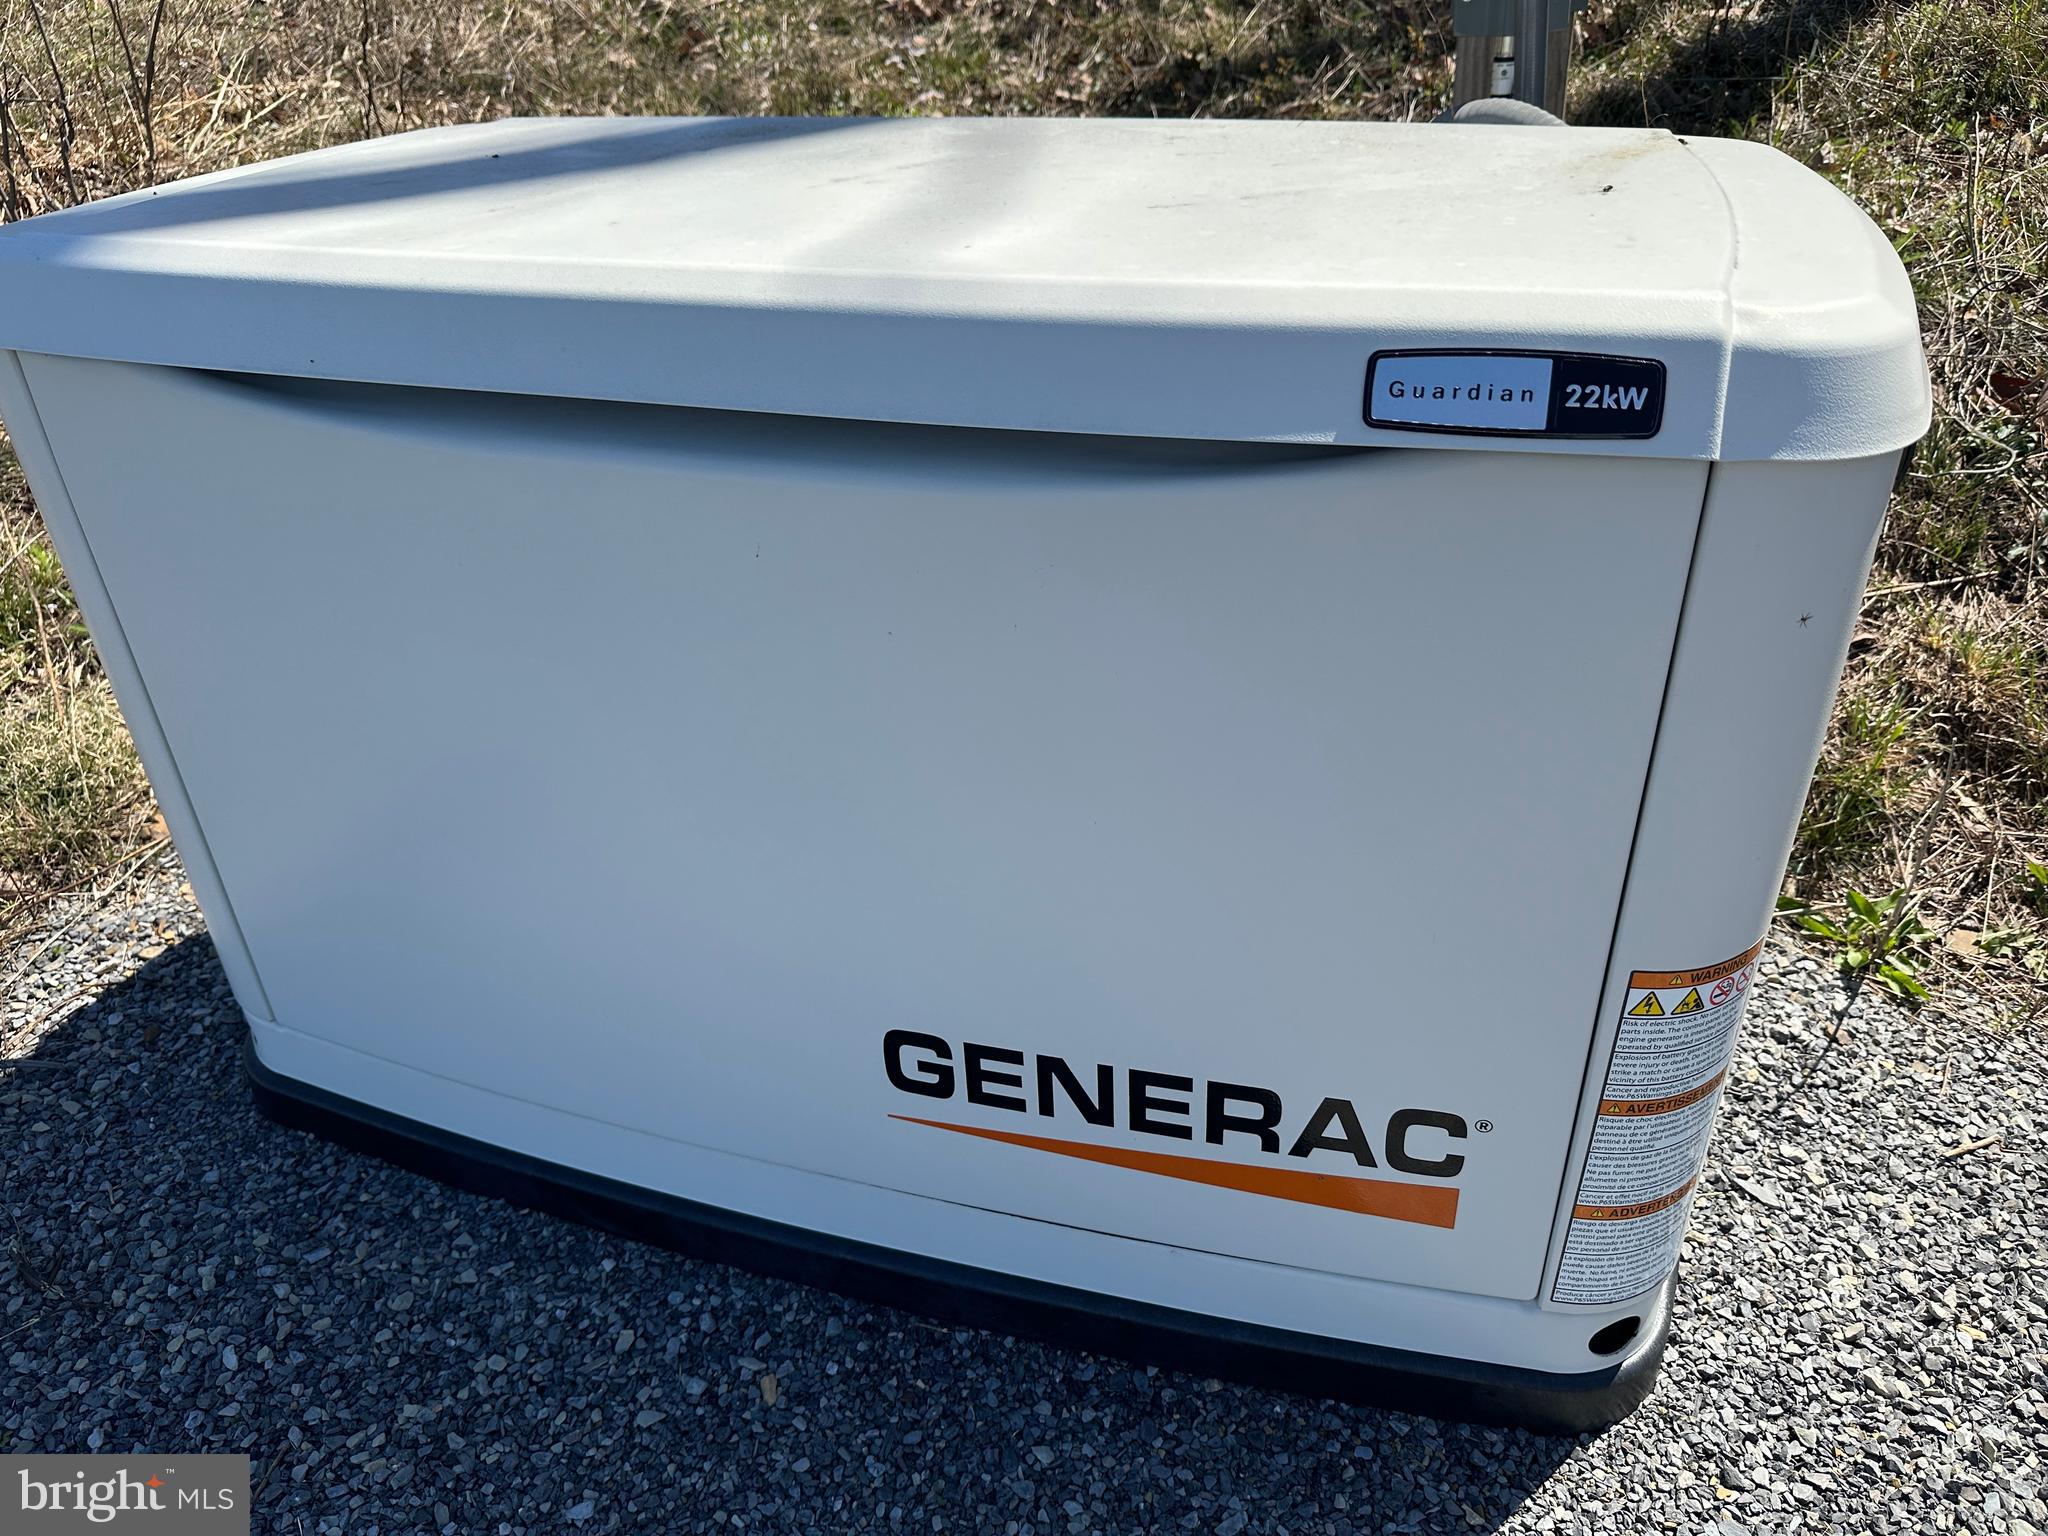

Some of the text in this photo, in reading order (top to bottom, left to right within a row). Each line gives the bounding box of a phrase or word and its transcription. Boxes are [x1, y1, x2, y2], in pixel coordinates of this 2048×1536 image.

[1389, 381, 1648, 410] Guardian 22kW
[1690, 954, 1749, 983] WARNING
[1682, 1020, 1704, 1031] control
[1647, 1035, 1683, 1043] generator
[1664, 1039, 1693, 1049] qualified
[1662, 1051, 1686, 1060] battery
[1670, 1057, 1690, 1066] death.
[1661, 1073, 1685, 1082] battery
[1650, 1080, 1690, 1093] reproductive
[1641, 1153, 1652, 1161] gaz
[1627, 1160, 1657, 1168] blessures
[1609, 1180, 1691, 1217] ADVERTENC
[1632, 1190, 1648, 1198] nocif
[1609, 1219, 1638, 1227] descarga
